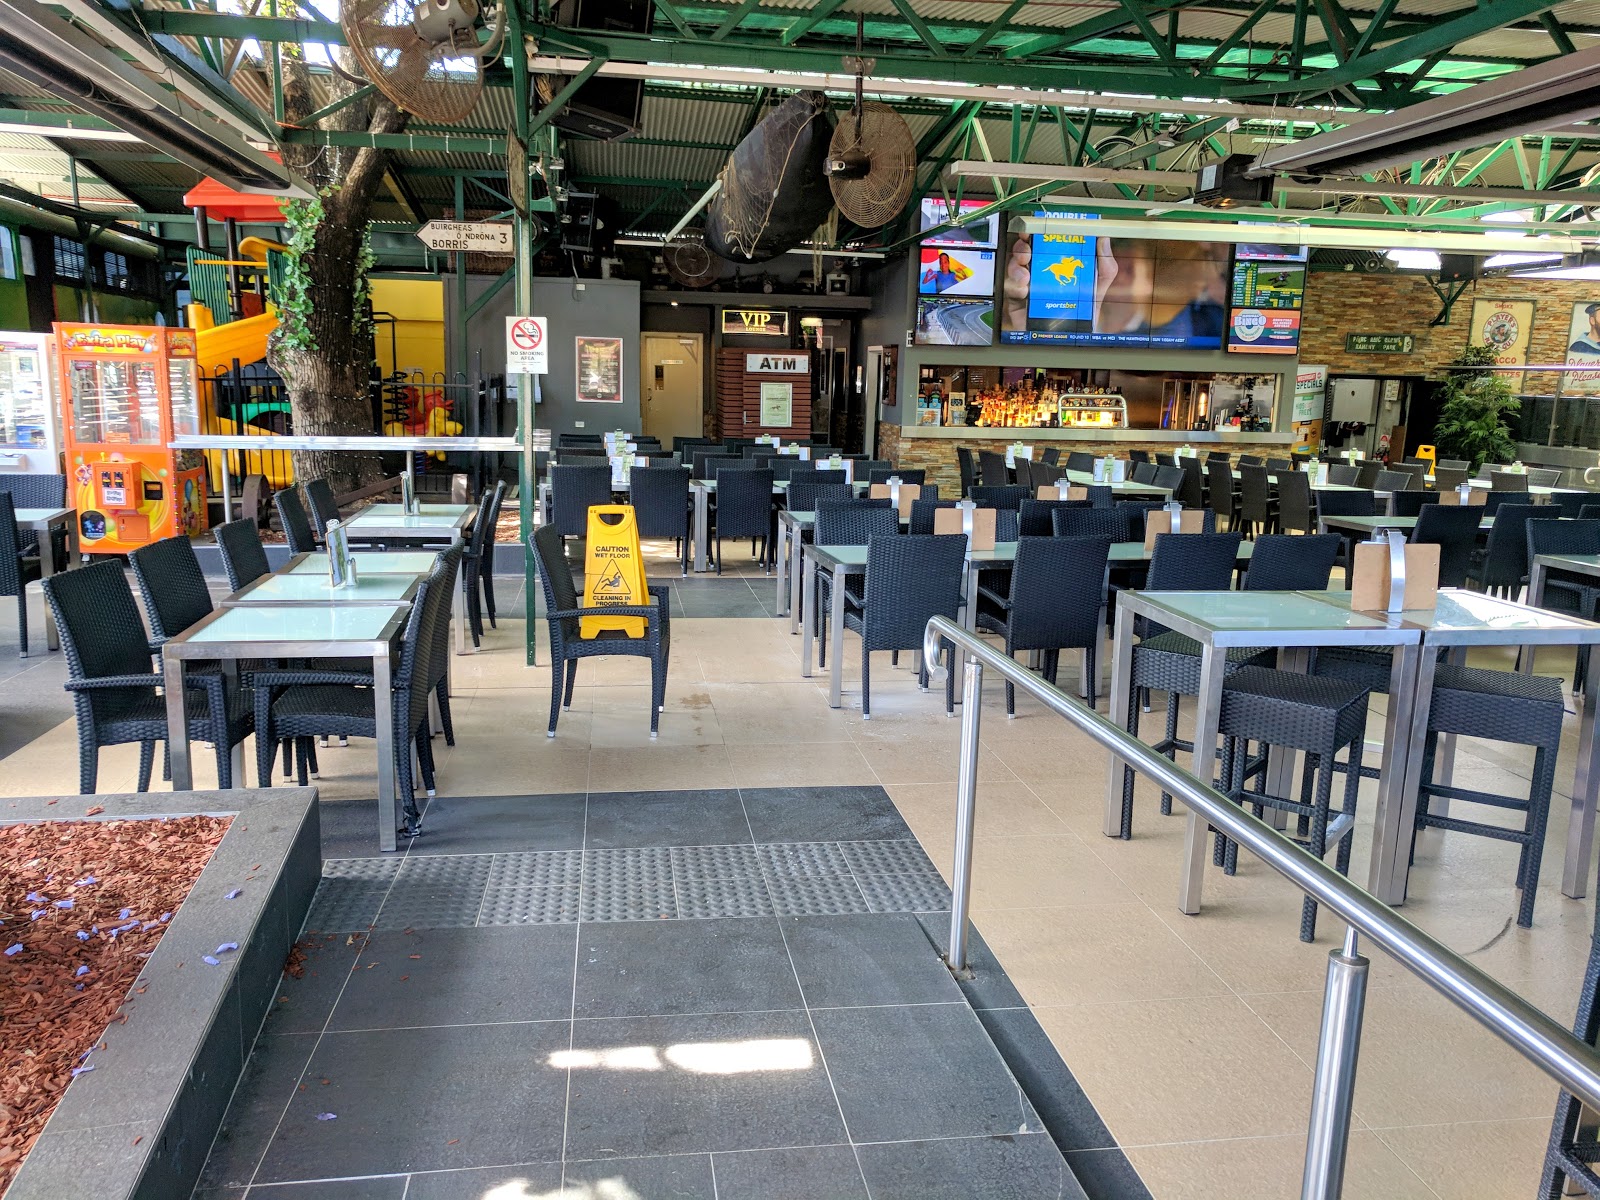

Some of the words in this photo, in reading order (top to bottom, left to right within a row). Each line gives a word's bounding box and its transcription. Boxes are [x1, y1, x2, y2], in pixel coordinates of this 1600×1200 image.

[430, 223, 473, 232] BUIRGHEAS
[432, 239, 469, 249] BORRIS
[499, 233, 508, 244] 3
[740, 312, 771, 327] VIP
[1234, 315, 1267, 326] BINGO
[75, 333, 114, 348] Extra
[115, 335, 147, 352] Play
[759, 357, 796, 370] ATM
[1296, 380, 1323, 390] SPECIALS
